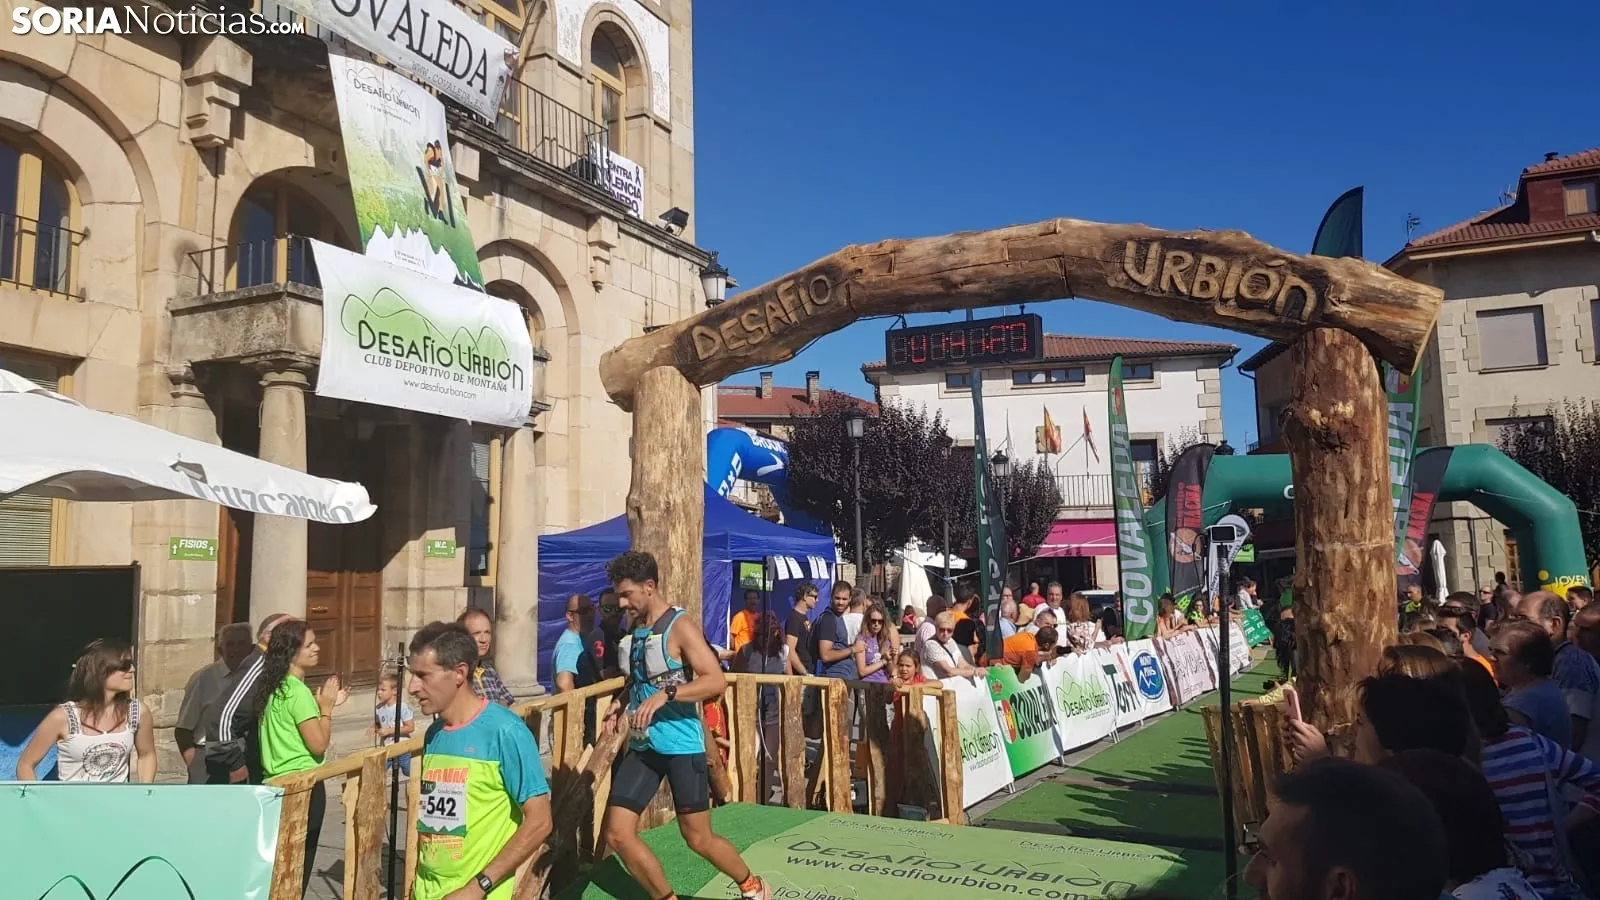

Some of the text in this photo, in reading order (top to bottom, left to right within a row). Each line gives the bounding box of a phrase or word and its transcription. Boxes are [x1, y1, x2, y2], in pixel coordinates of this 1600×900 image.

[364, 353, 507, 393] CLUB DEPORTIVO DE MONTAÑA
[403, 378, 477, 400] www.desafiourbion.com
[179, 539, 209, 549] FISIOS
[1554, 575, 1588, 588] JOVEN
[427, 796, 456, 816] 542
[787, 855, 1092, 900] www.desafiourbion.com
